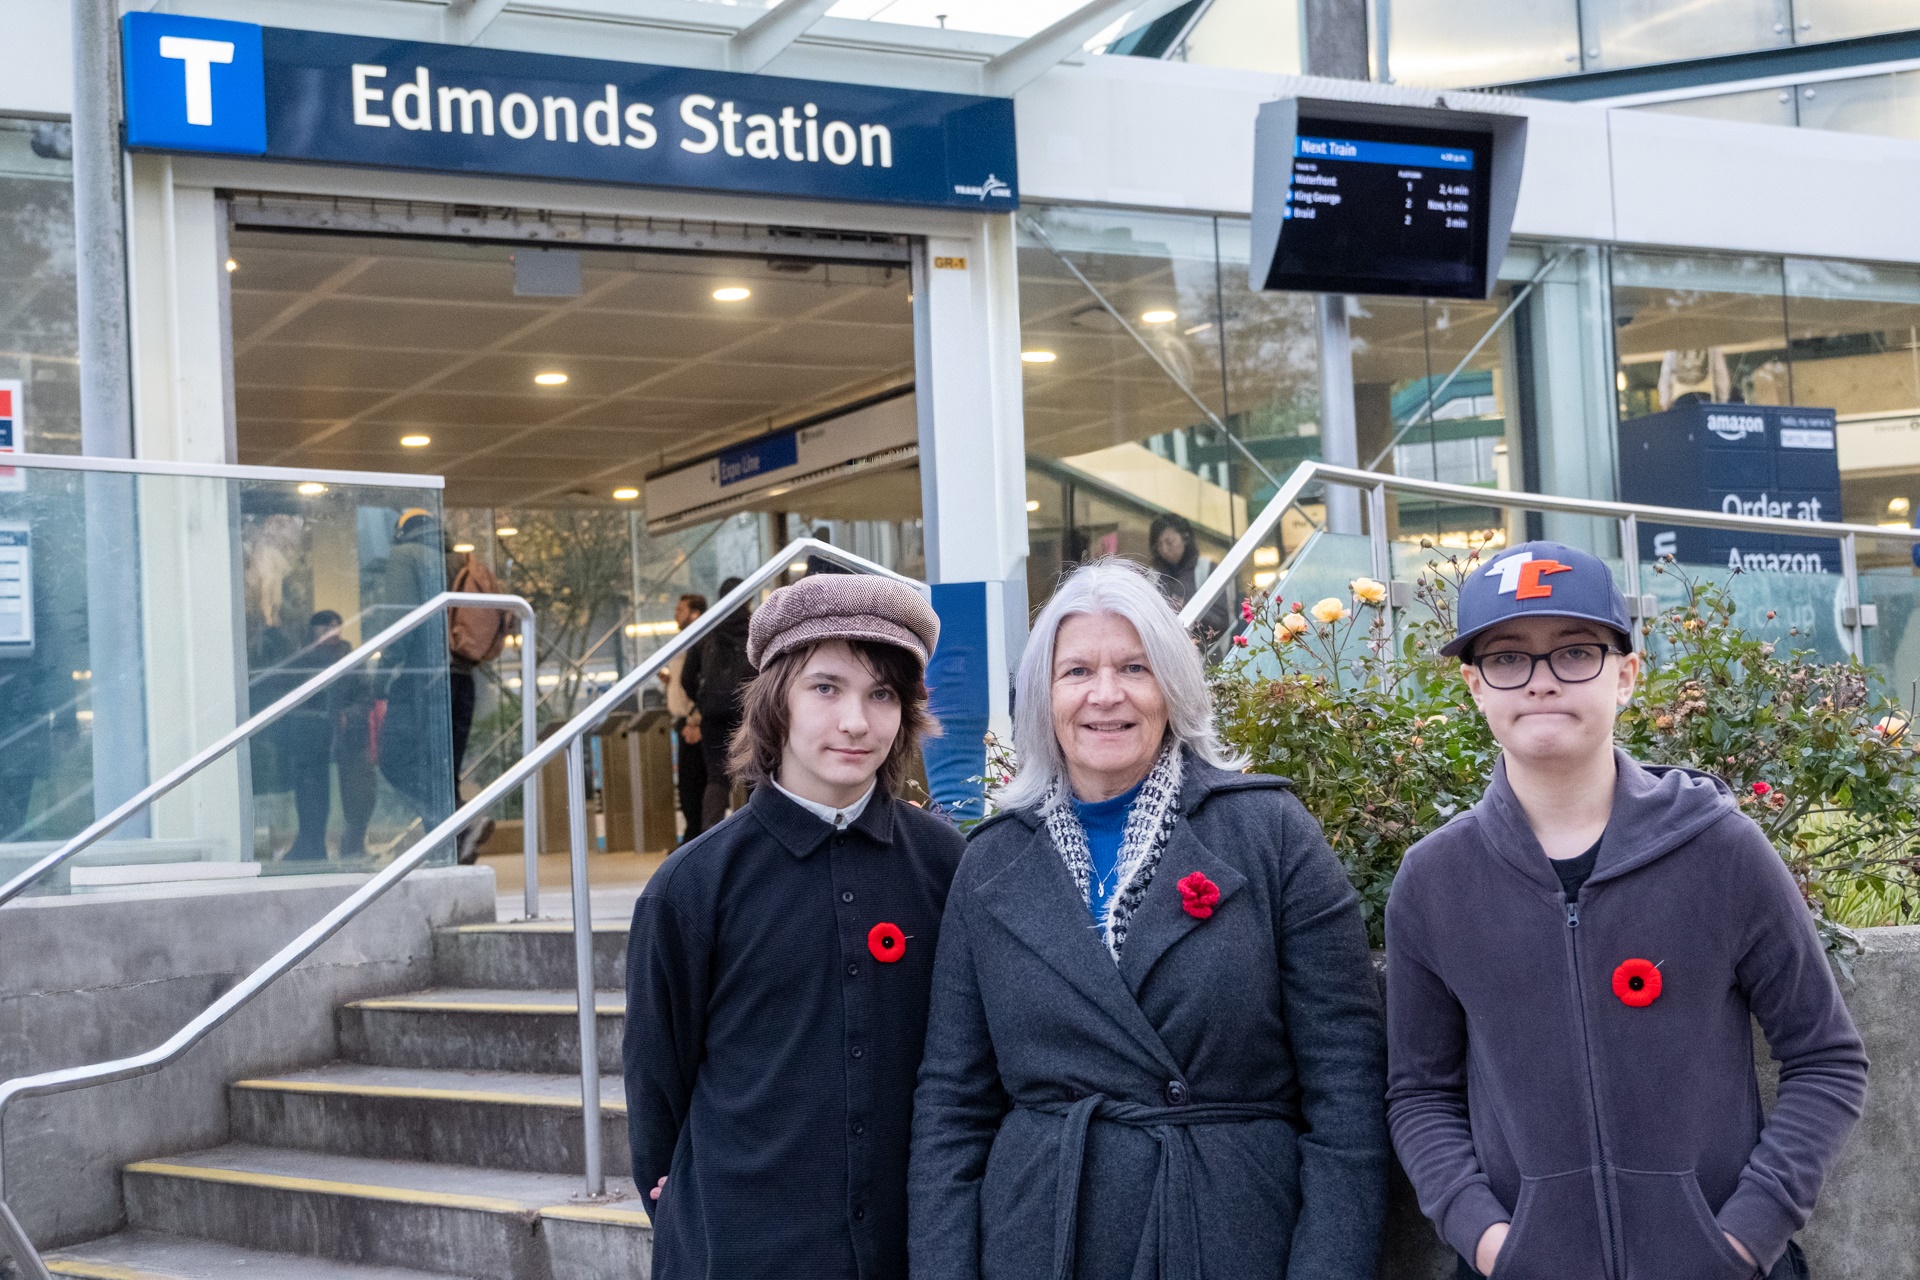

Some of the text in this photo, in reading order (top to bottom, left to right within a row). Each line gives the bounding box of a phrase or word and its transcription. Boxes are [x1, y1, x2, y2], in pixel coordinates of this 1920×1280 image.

[159, 35, 235, 126] T
[352, 63, 892, 168] Edmonds Station
[1301, 140, 1357, 157] Next Train
[1295, 174, 1337, 187] Waterfront
[1407, 181, 1413, 192] 1
[1294, 190, 1312, 204] King
[1312, 191, 1342, 206] George
[1405, 197, 1412, 209] 2
[1294, 207, 1316, 219] Braid
[1707, 414, 1764, 435] amazon
[1722, 493, 1822, 522] Order at
